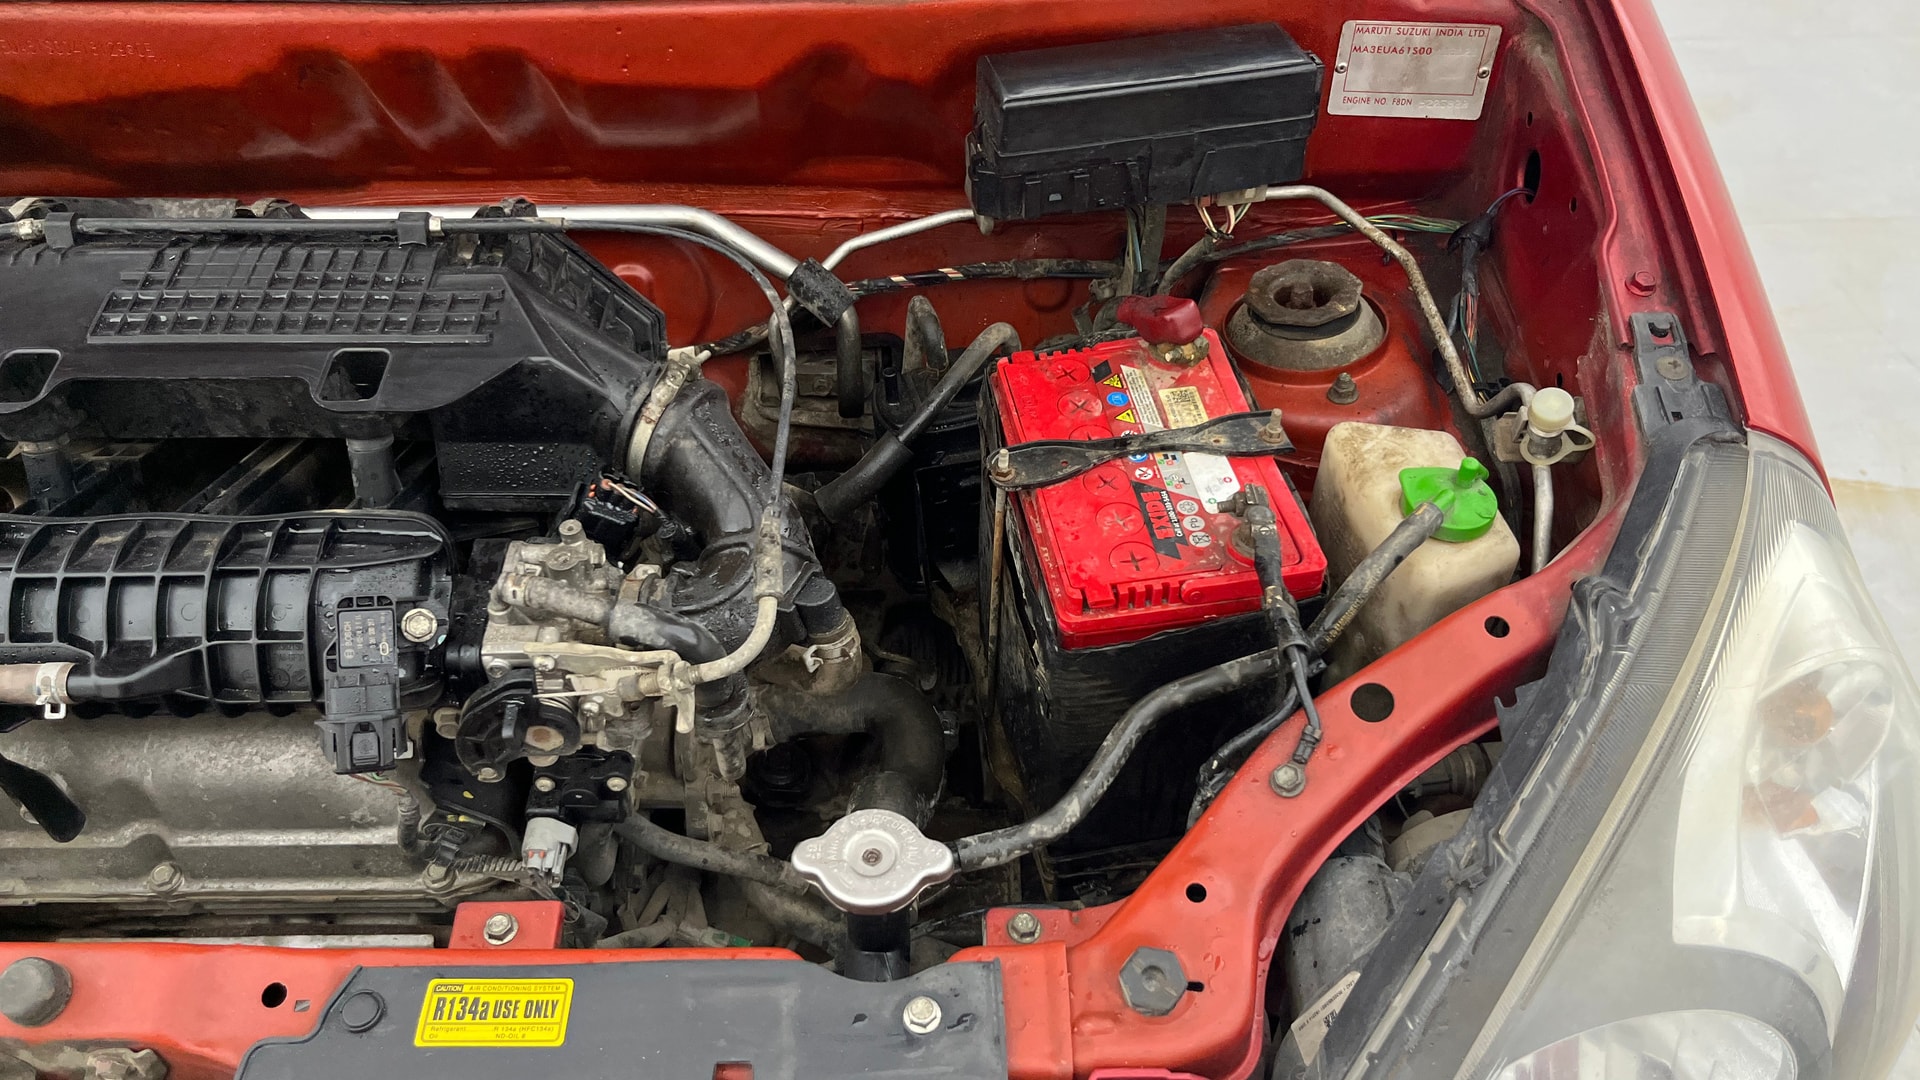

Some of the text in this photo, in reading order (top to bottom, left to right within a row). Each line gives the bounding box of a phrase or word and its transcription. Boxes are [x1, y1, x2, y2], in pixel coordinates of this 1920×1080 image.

[1355, 26, 1392, 35] MARUTI
[1396, 27, 1431, 36] SUZUKI
[1435, 28, 1463, 37] INDIA
[1342, 96, 1371, 105] ENGINE
[1391, 98, 1413, 106] F8DN
[1141, 492, 1174, 539] EXIDE
[1190, 518, 1200, 528] Pb
[344, 621, 352, 647] BOSCH
[432, 996, 560, 1021] R134a USE ONLY
